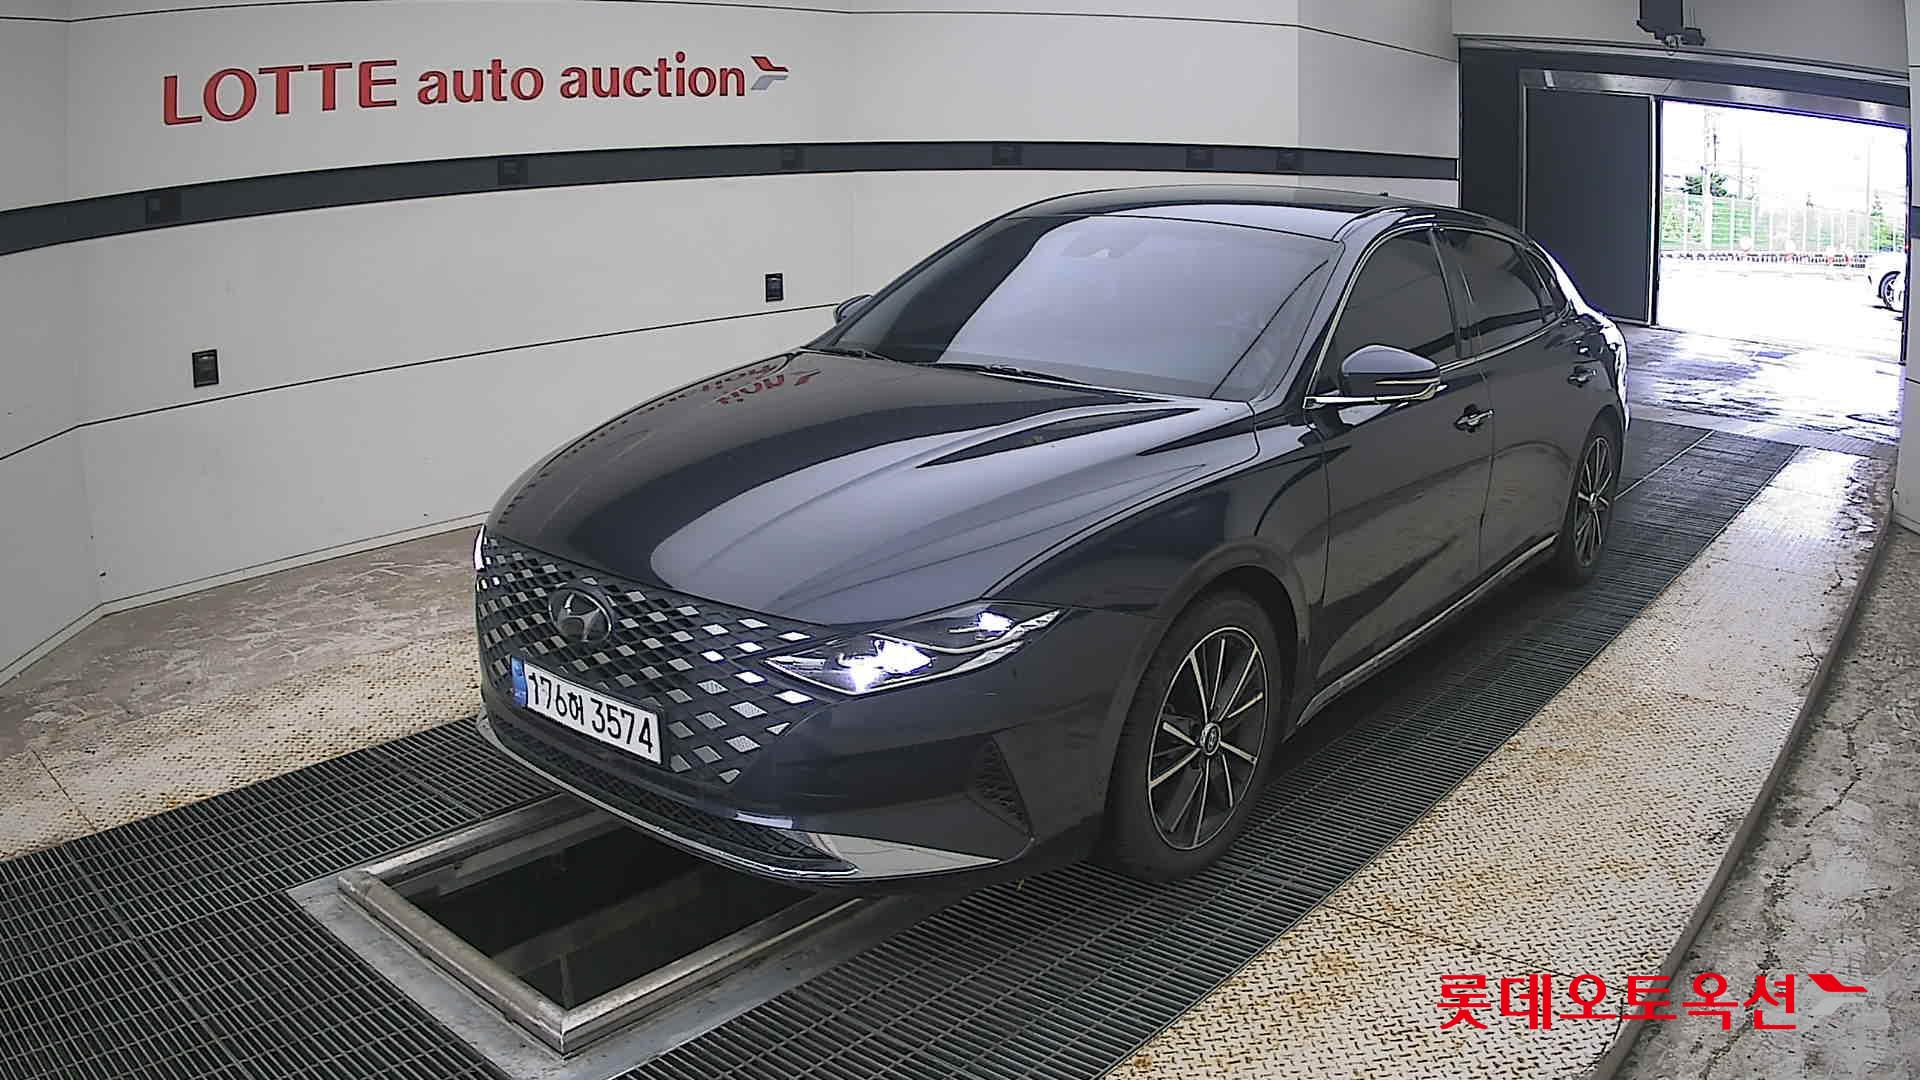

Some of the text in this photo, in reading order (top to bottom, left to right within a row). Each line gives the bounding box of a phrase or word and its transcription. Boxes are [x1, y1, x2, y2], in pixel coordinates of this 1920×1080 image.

[163, 51, 746, 126] LOTTE auto auction
[590, 698, 653, 753] 3574
